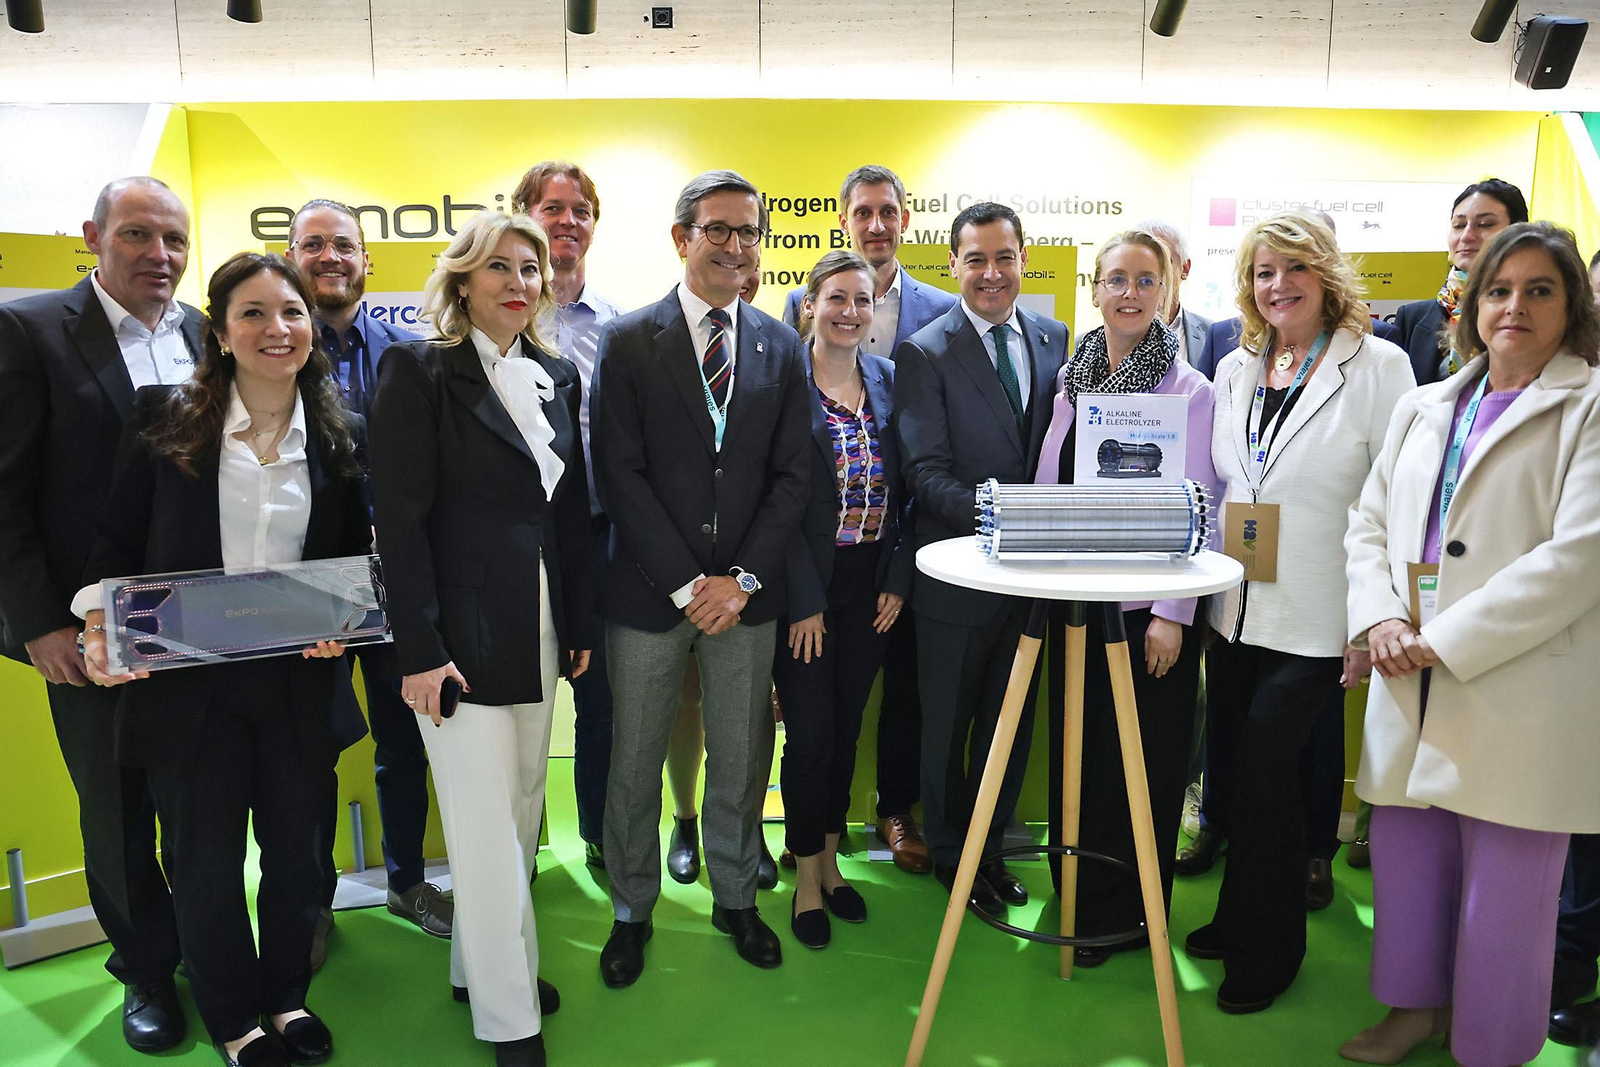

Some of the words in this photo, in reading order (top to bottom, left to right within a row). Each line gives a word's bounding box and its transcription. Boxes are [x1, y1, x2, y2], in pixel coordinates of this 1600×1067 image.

[1010, 194, 1123, 215] Solutions
[1352, 201, 1383, 213] cell
[765, 229, 820, 249] from
[1207, 248, 1237, 257] prese
[1105, 410, 1142, 418] ALKALINE
[1105, 418, 1162, 427] ELECTROLYZER
[225, 606, 259, 618] EKPO
